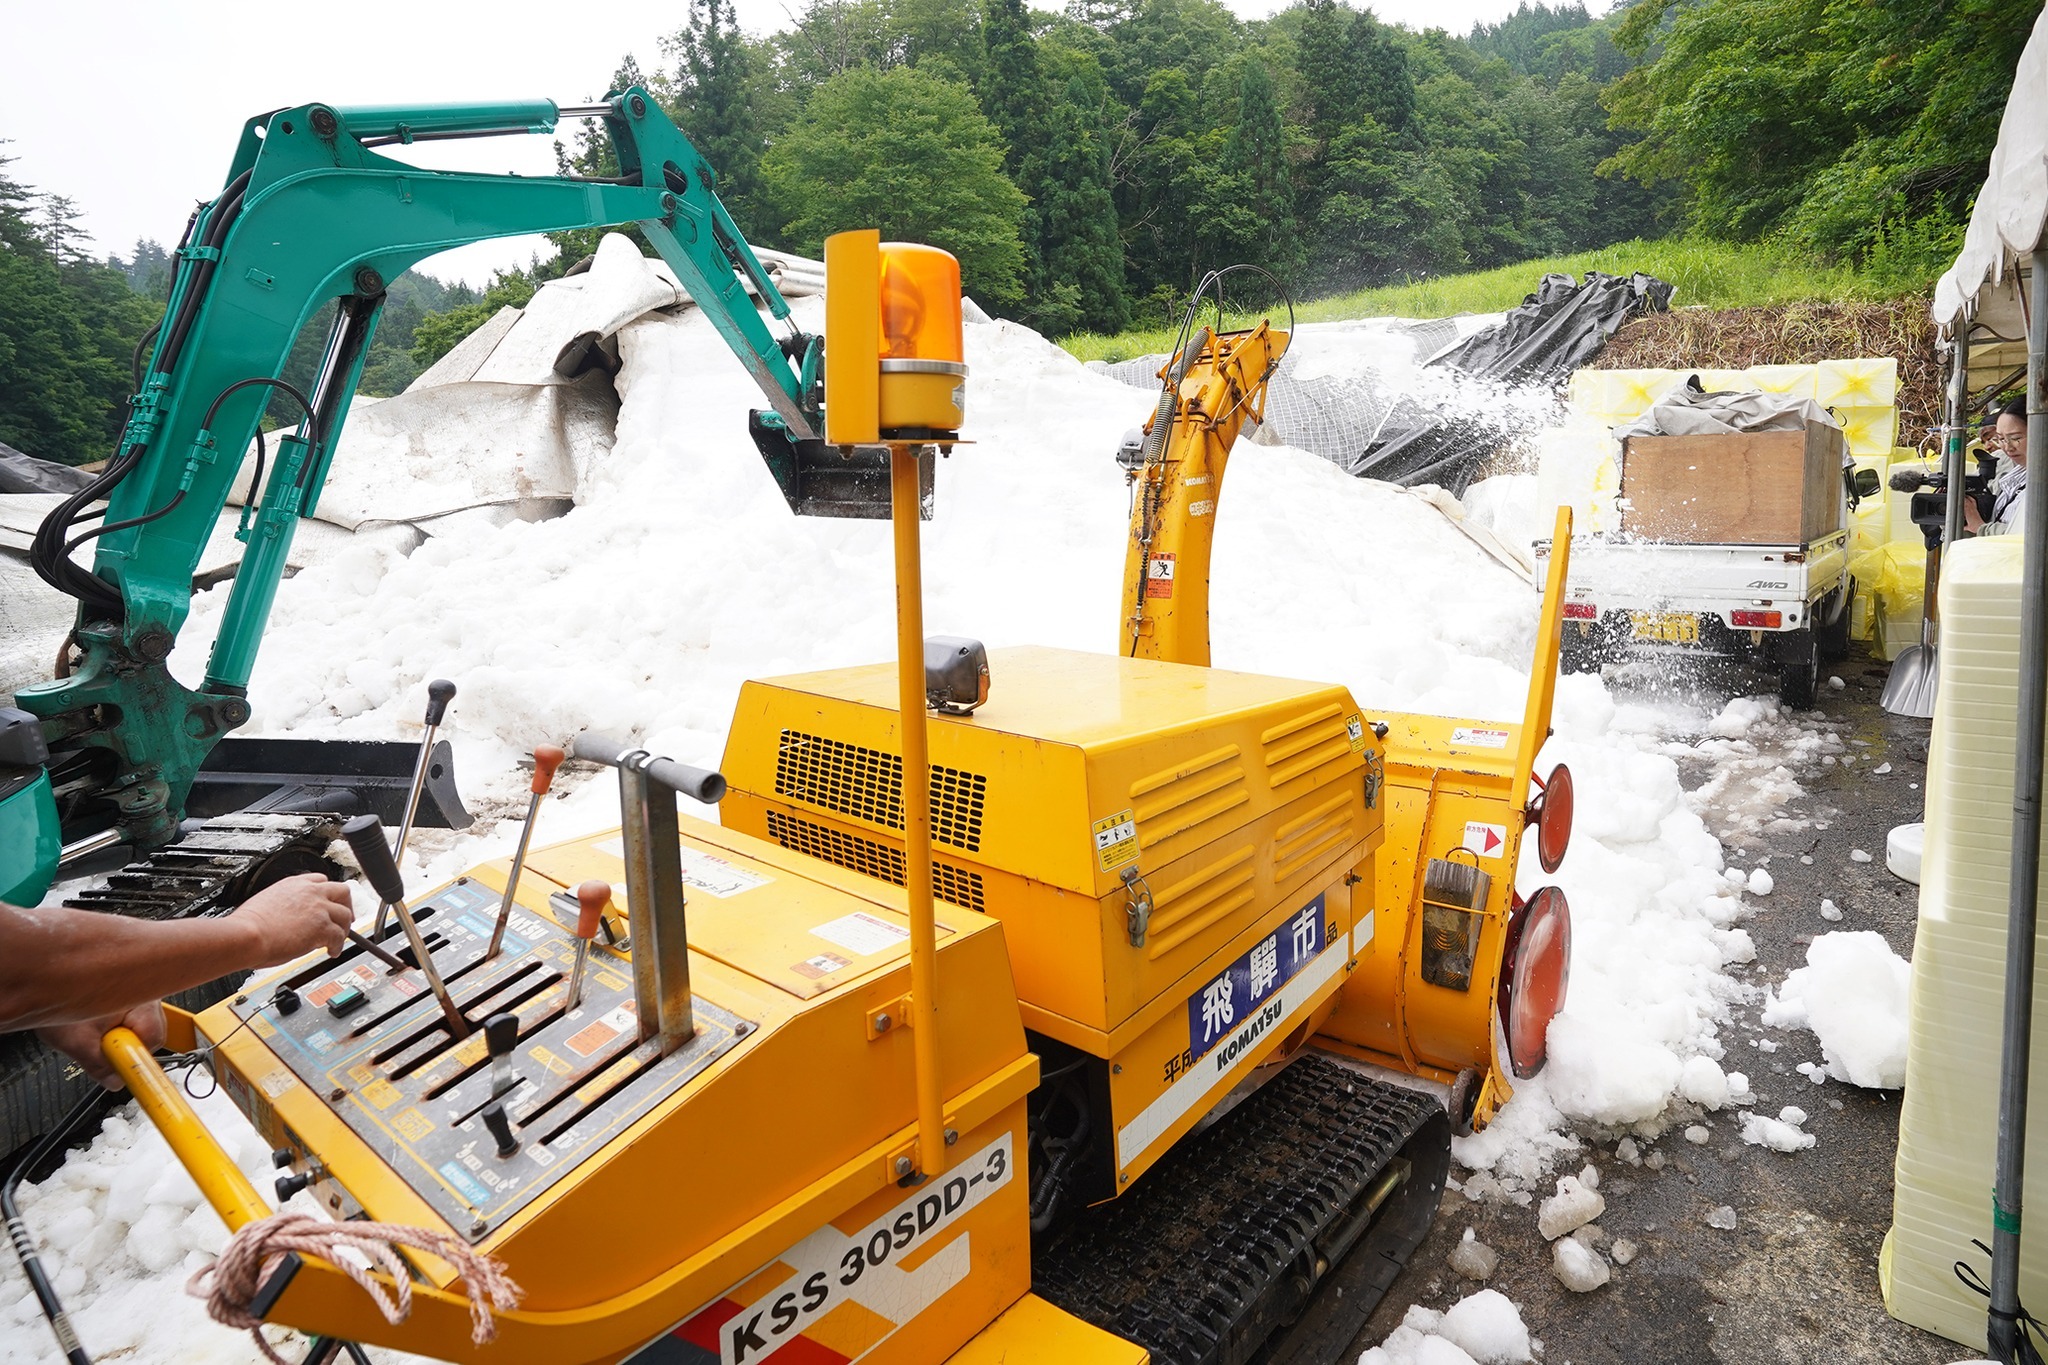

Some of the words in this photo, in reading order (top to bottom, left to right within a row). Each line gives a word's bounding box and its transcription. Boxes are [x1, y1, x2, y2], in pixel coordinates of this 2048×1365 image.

[1217, 999, 1282, 1071] KOMATSU
[733, 1271, 829, 1365] KSS
[840, 1148, 1007, 1286] 30SDD-3
